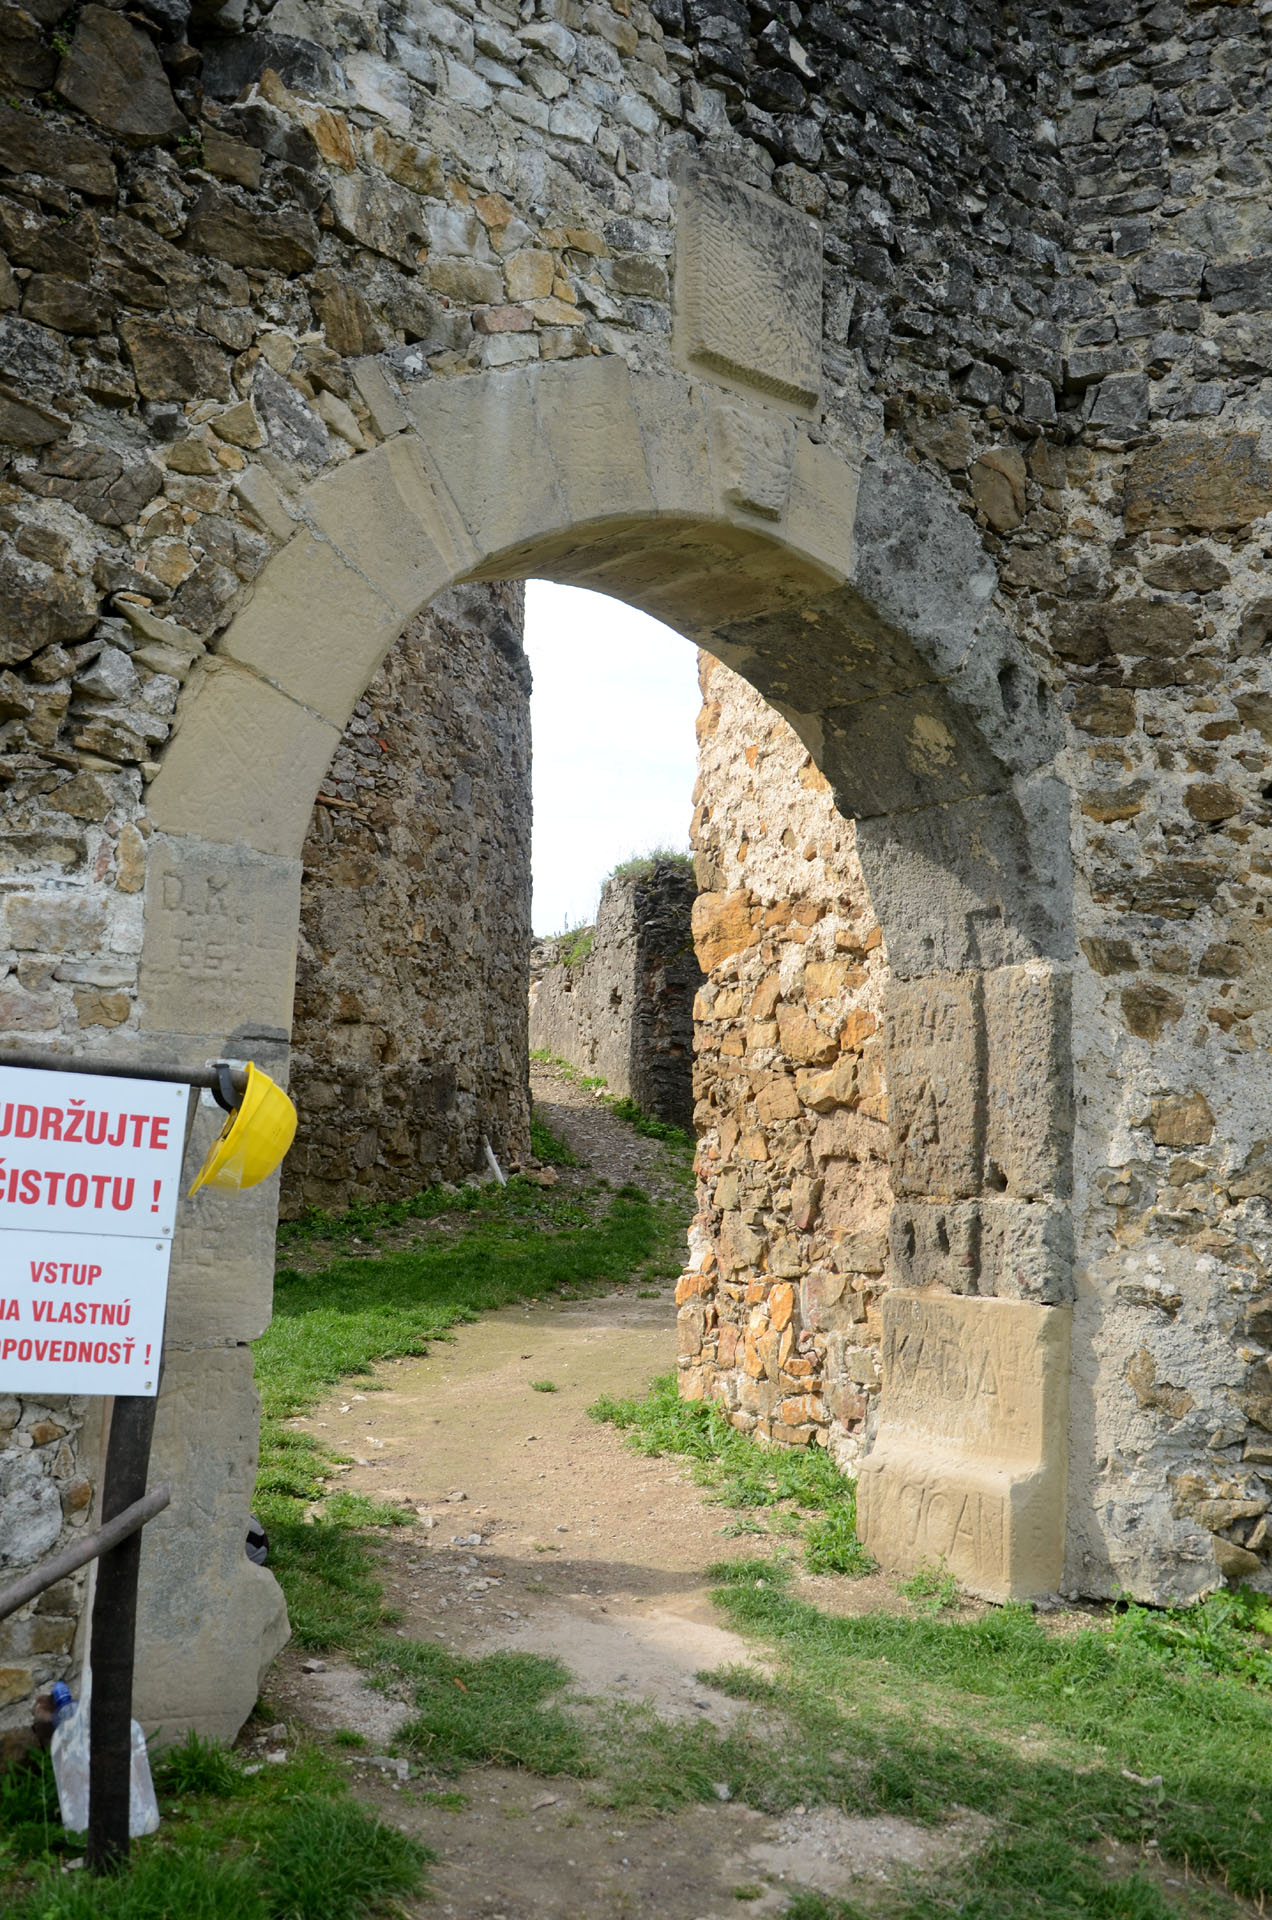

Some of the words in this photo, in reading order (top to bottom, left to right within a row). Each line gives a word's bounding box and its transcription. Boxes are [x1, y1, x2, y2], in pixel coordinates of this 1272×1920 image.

[0, 1099, 170, 1149] UDRŽUJTE
[151, 1180, 161, 1212] !
[30, 1261, 101, 1285] VSTUP
[32, 1299, 130, 1326] VLASTNÚ
[0, 1337, 135, 1364] POVEDNOSŤ
[144, 1344, 151, 1365] !
